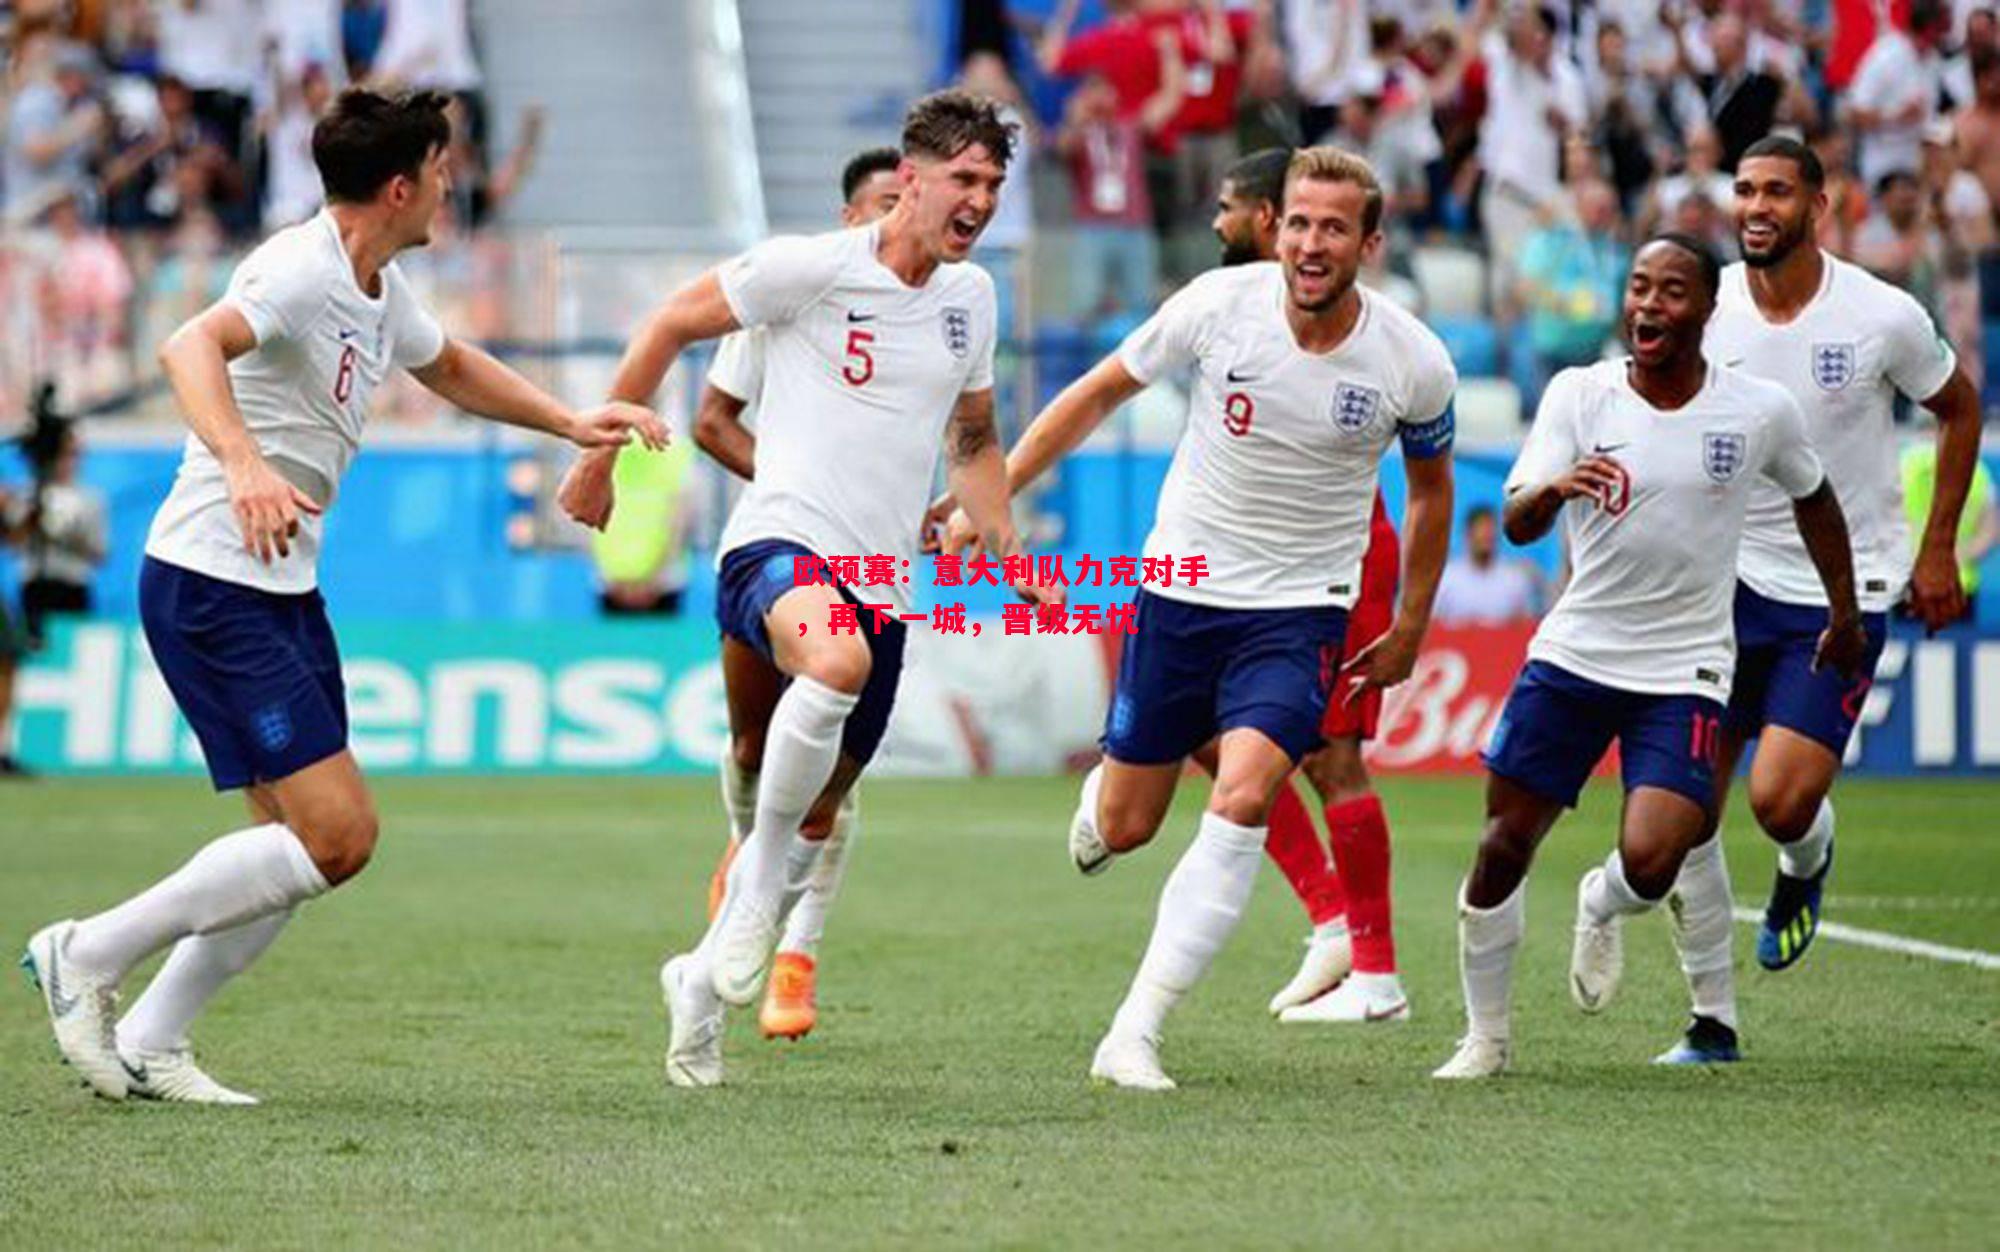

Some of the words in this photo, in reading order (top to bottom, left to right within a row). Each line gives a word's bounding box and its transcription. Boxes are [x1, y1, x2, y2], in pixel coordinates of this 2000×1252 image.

[334, 344, 356, 404] 6
[843, 329, 875, 387] 5
[1223, 391, 1254, 437] 9
[1602, 463, 1631, 517] 0
[12, 624, 731, 766] Hiense
